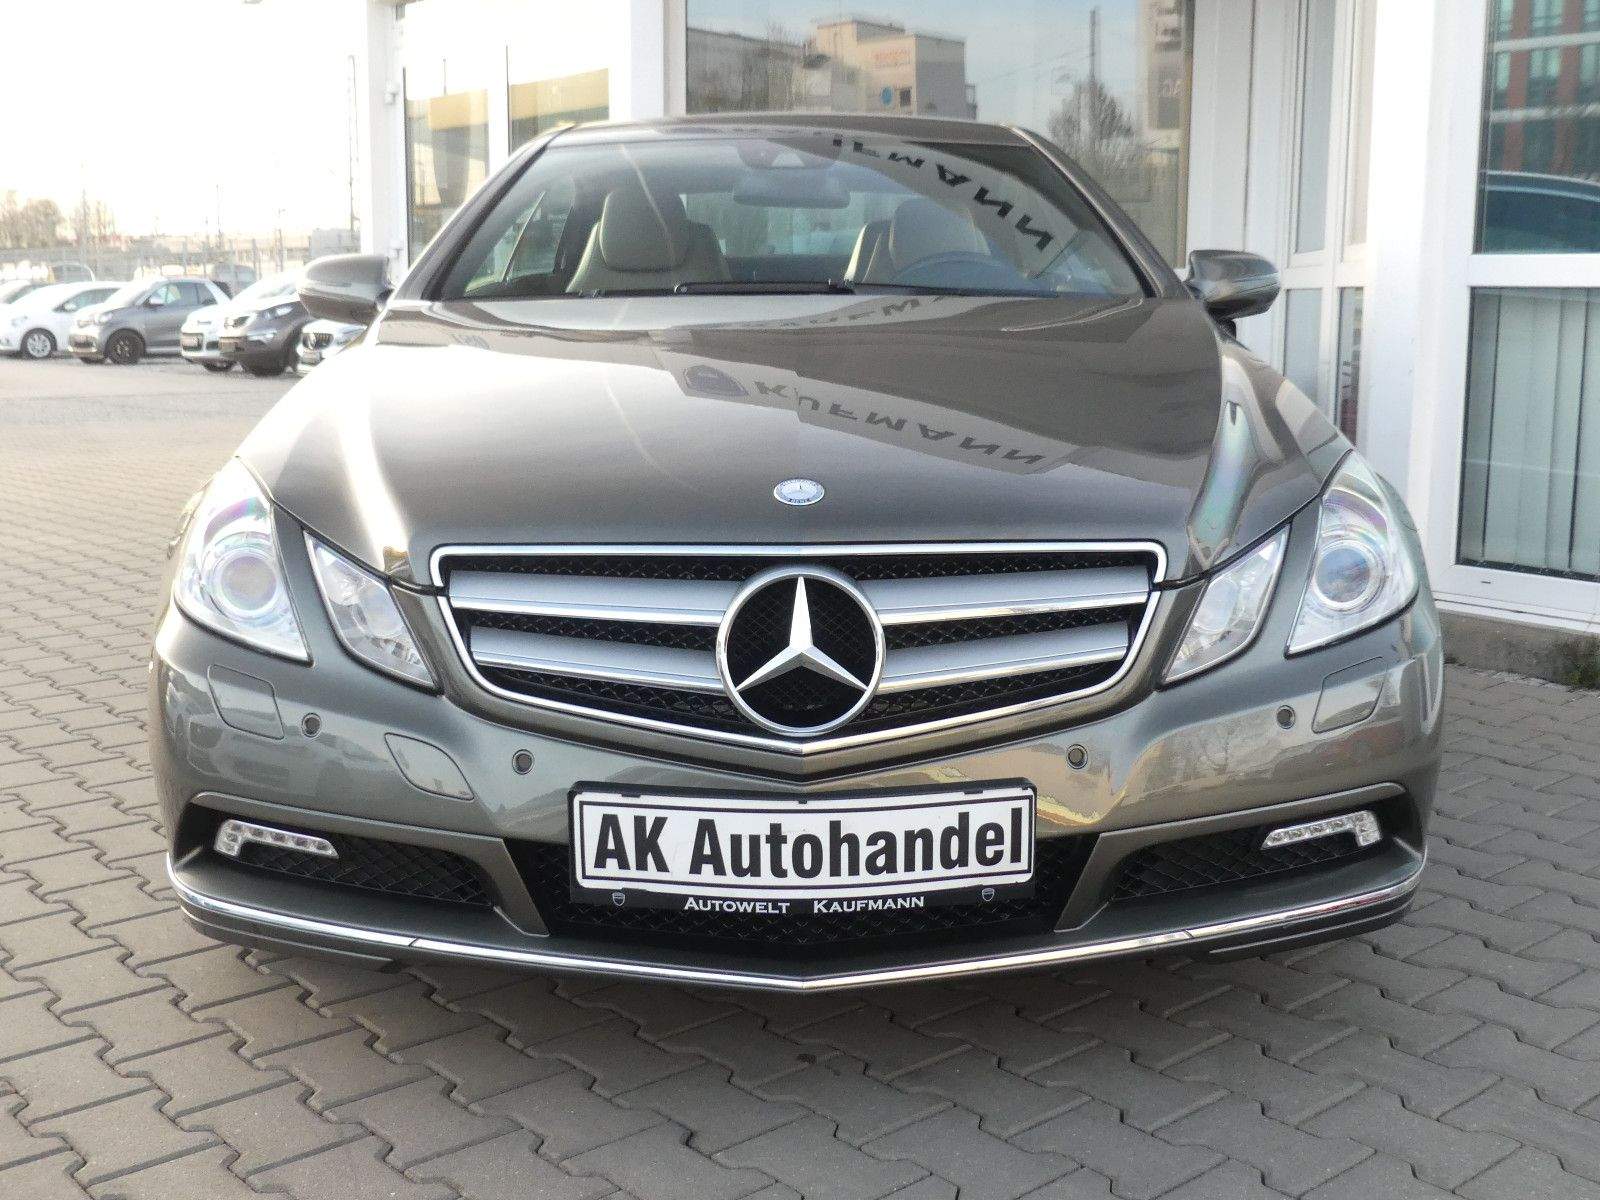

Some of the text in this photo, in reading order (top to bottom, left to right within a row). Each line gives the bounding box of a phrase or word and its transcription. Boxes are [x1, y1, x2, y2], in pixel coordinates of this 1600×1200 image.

[593, 806, 1023, 879] AK Autohandel
[683, 895, 925, 914] AUTOWELT KAUFMANN
